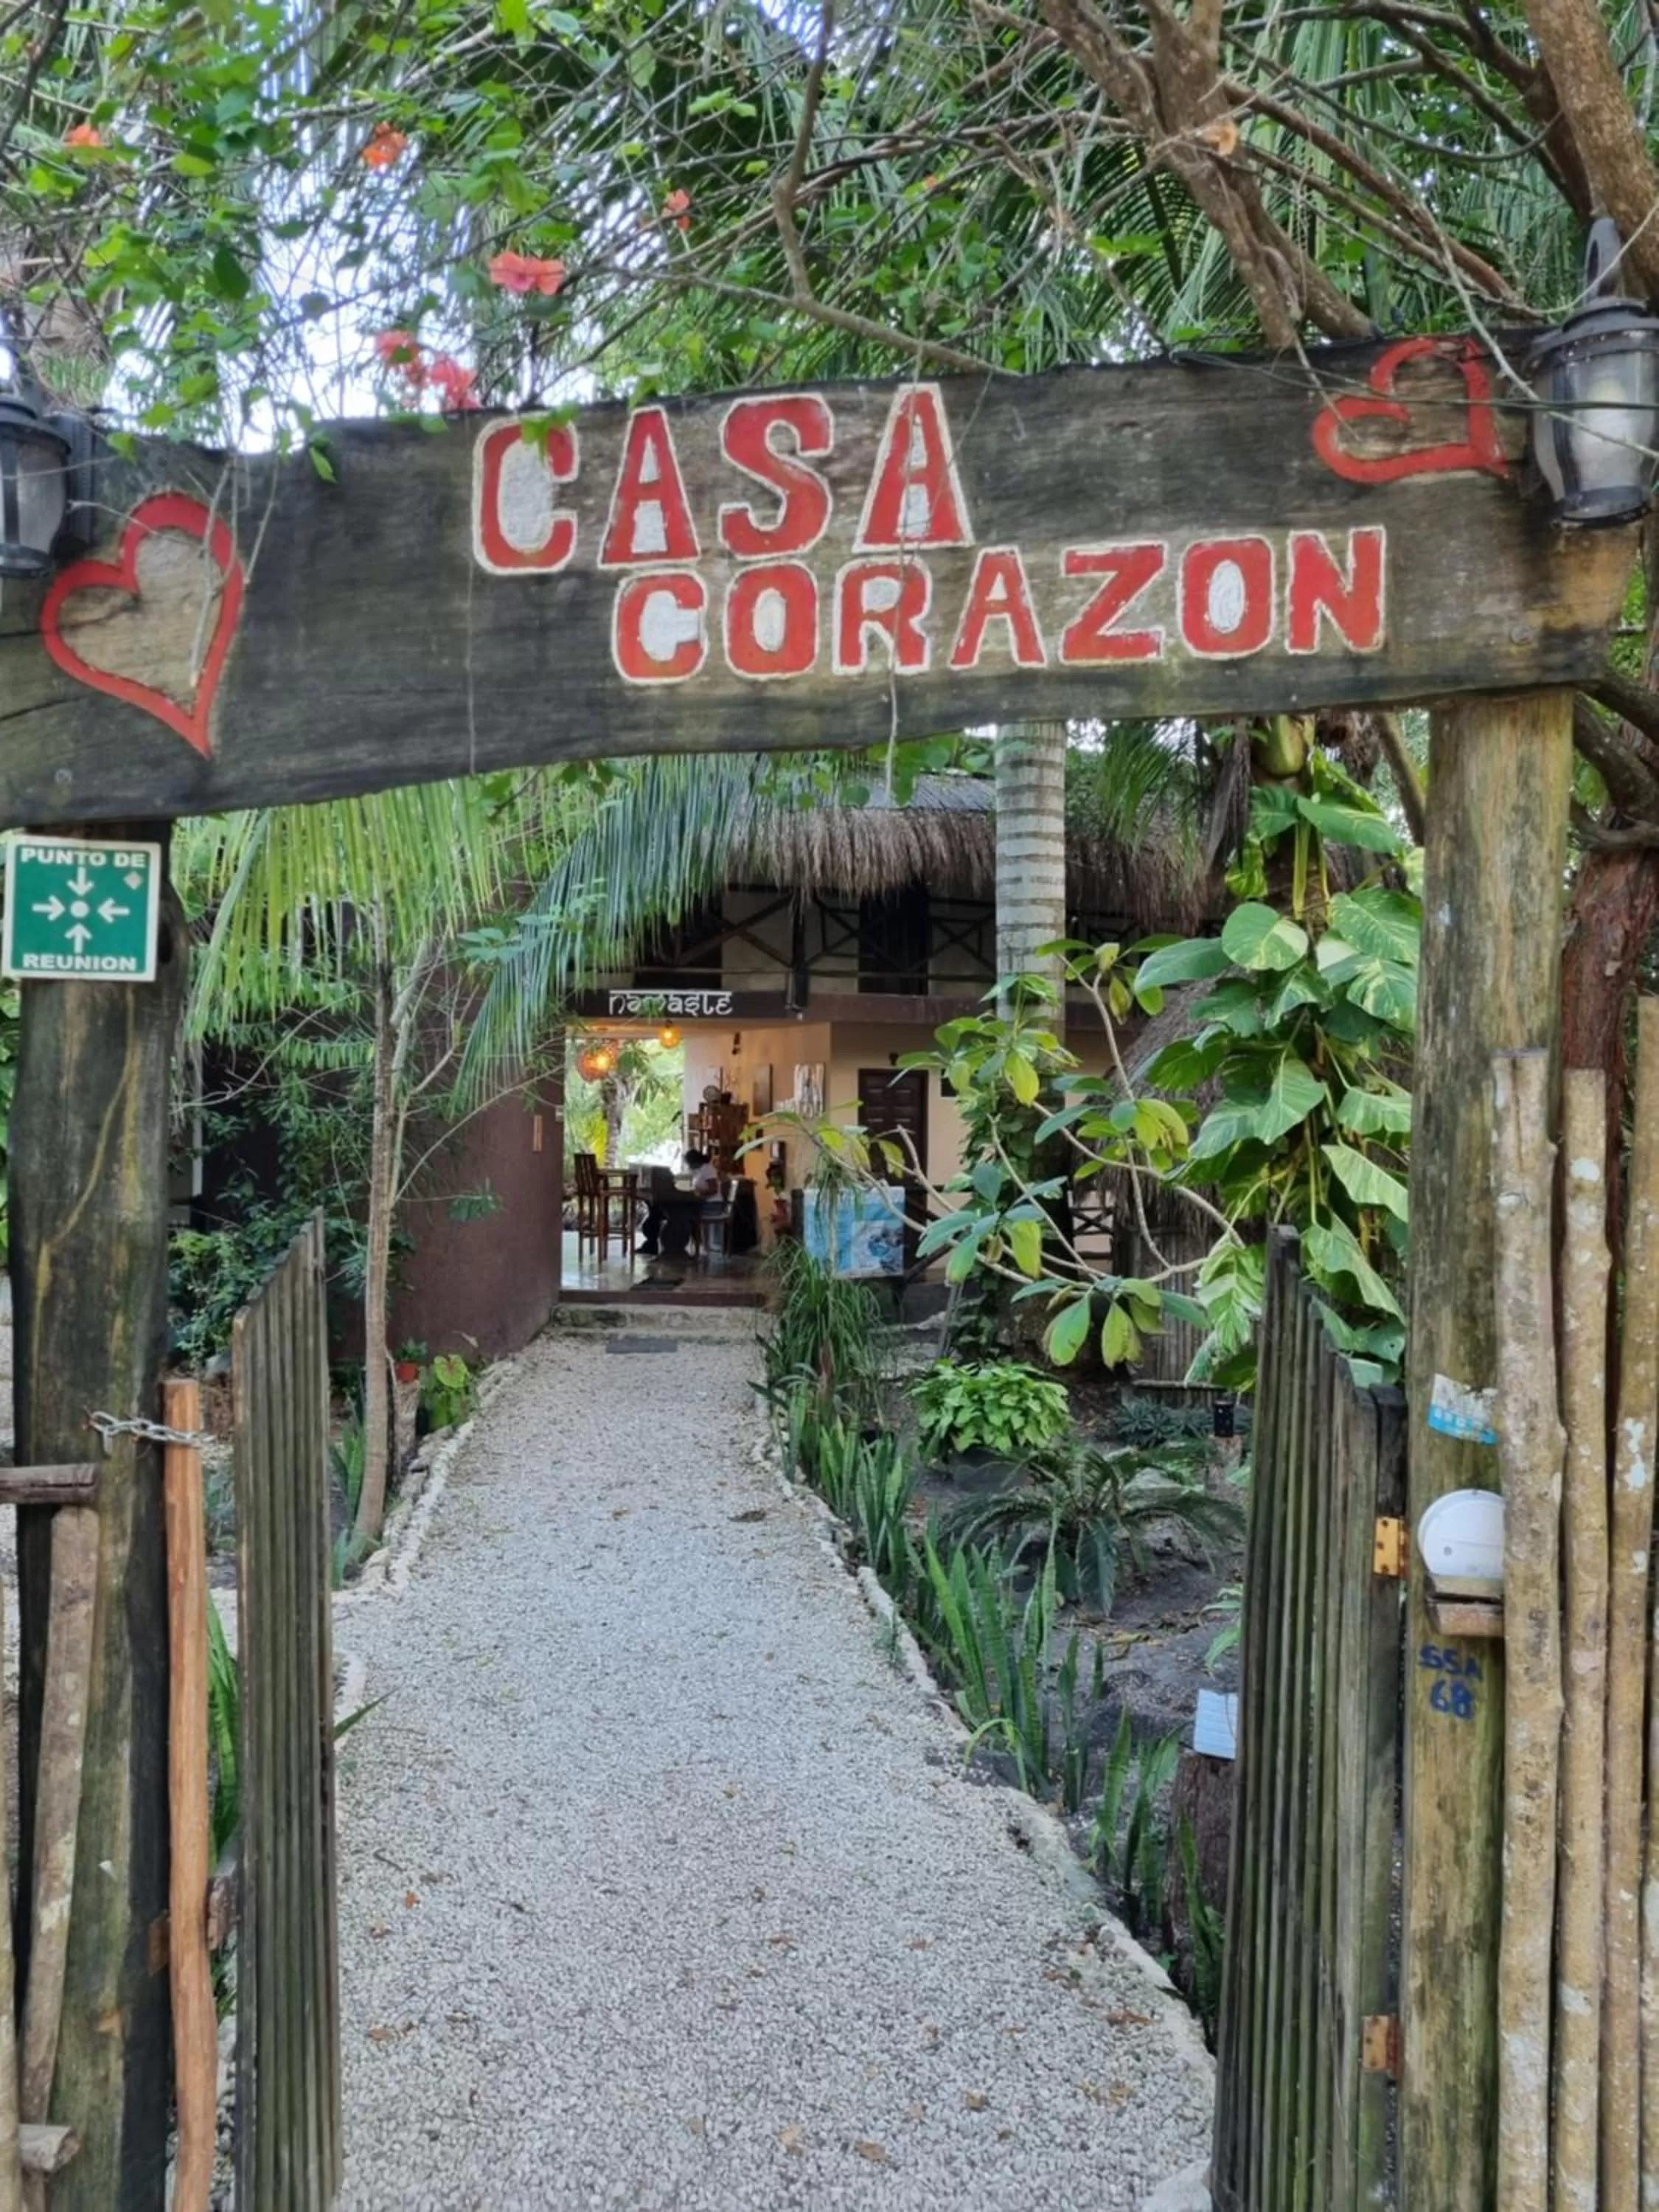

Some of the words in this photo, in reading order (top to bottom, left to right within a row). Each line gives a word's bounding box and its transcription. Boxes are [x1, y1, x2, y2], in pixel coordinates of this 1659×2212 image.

[472, 382, 975, 575] CASA
[611, 526, 1386, 685] CORAZON
[20, 847, 108, 867] PUNTO
[114, 852, 147, 868] DE
[21, 953, 138, 971] REUNION
[1430, 1679, 1473, 1721] 68
